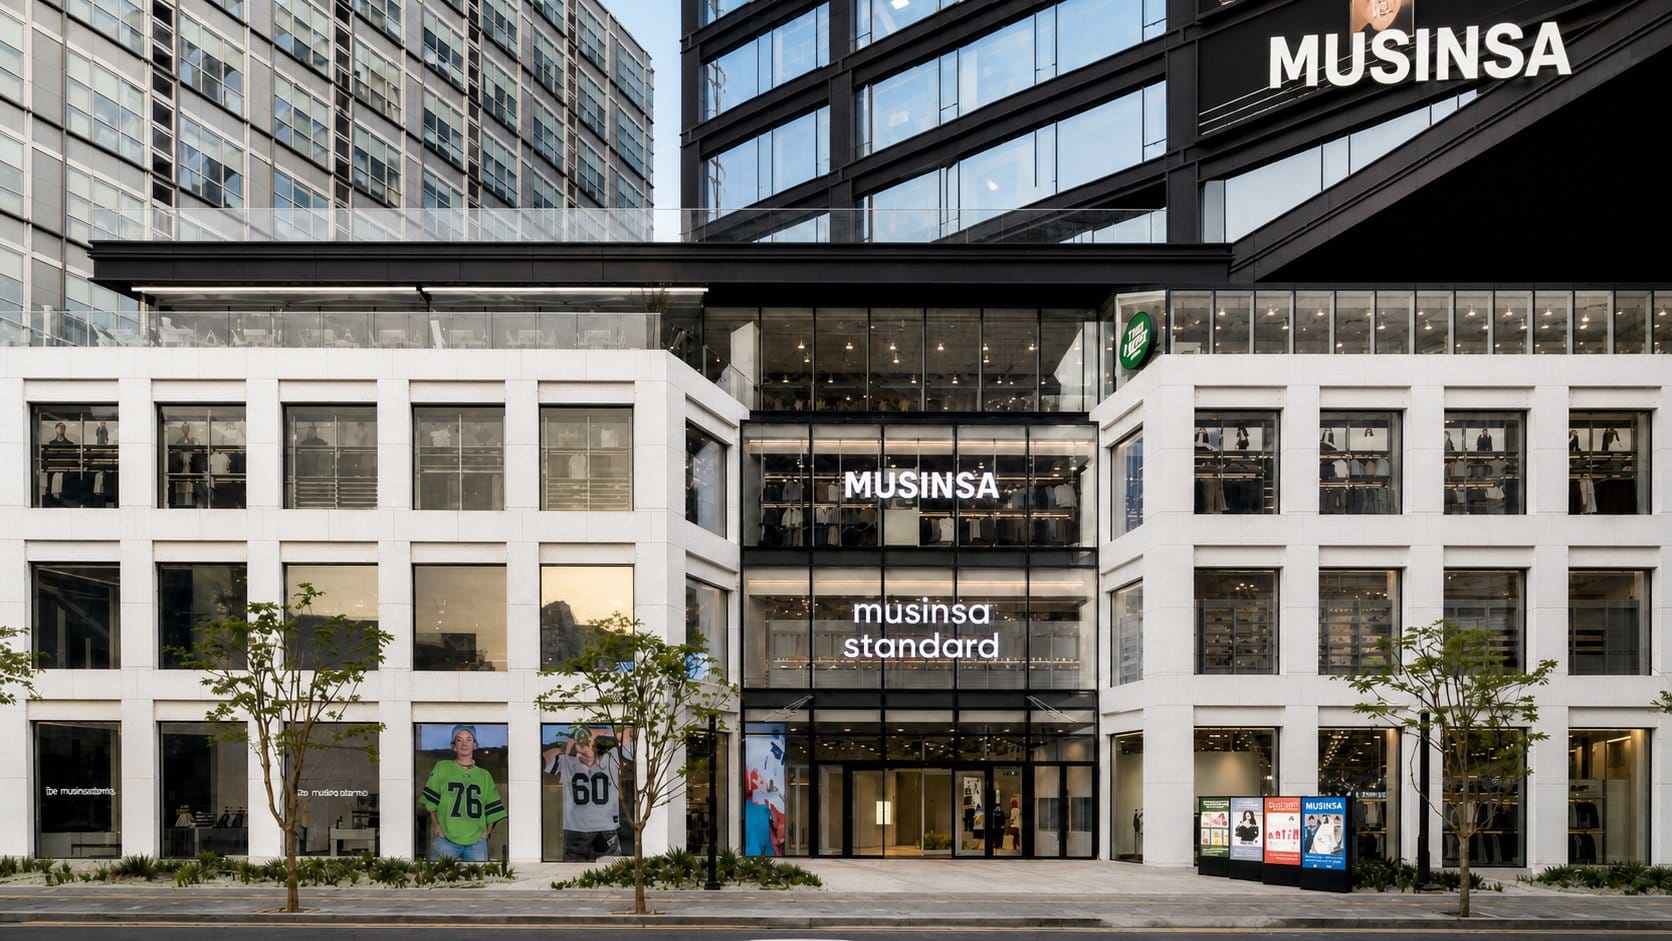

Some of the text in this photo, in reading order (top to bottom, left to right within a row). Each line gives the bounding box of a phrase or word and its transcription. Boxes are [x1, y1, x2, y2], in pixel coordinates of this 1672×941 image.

[1269, 21, 1573, 89] MUSINSA
[844, 471, 1000, 499] MUSINSA
[853, 597, 990, 624] musinsa
[843, 632, 999, 659] standard
[447, 782, 483, 819] 76
[571, 772, 609, 805] 60
